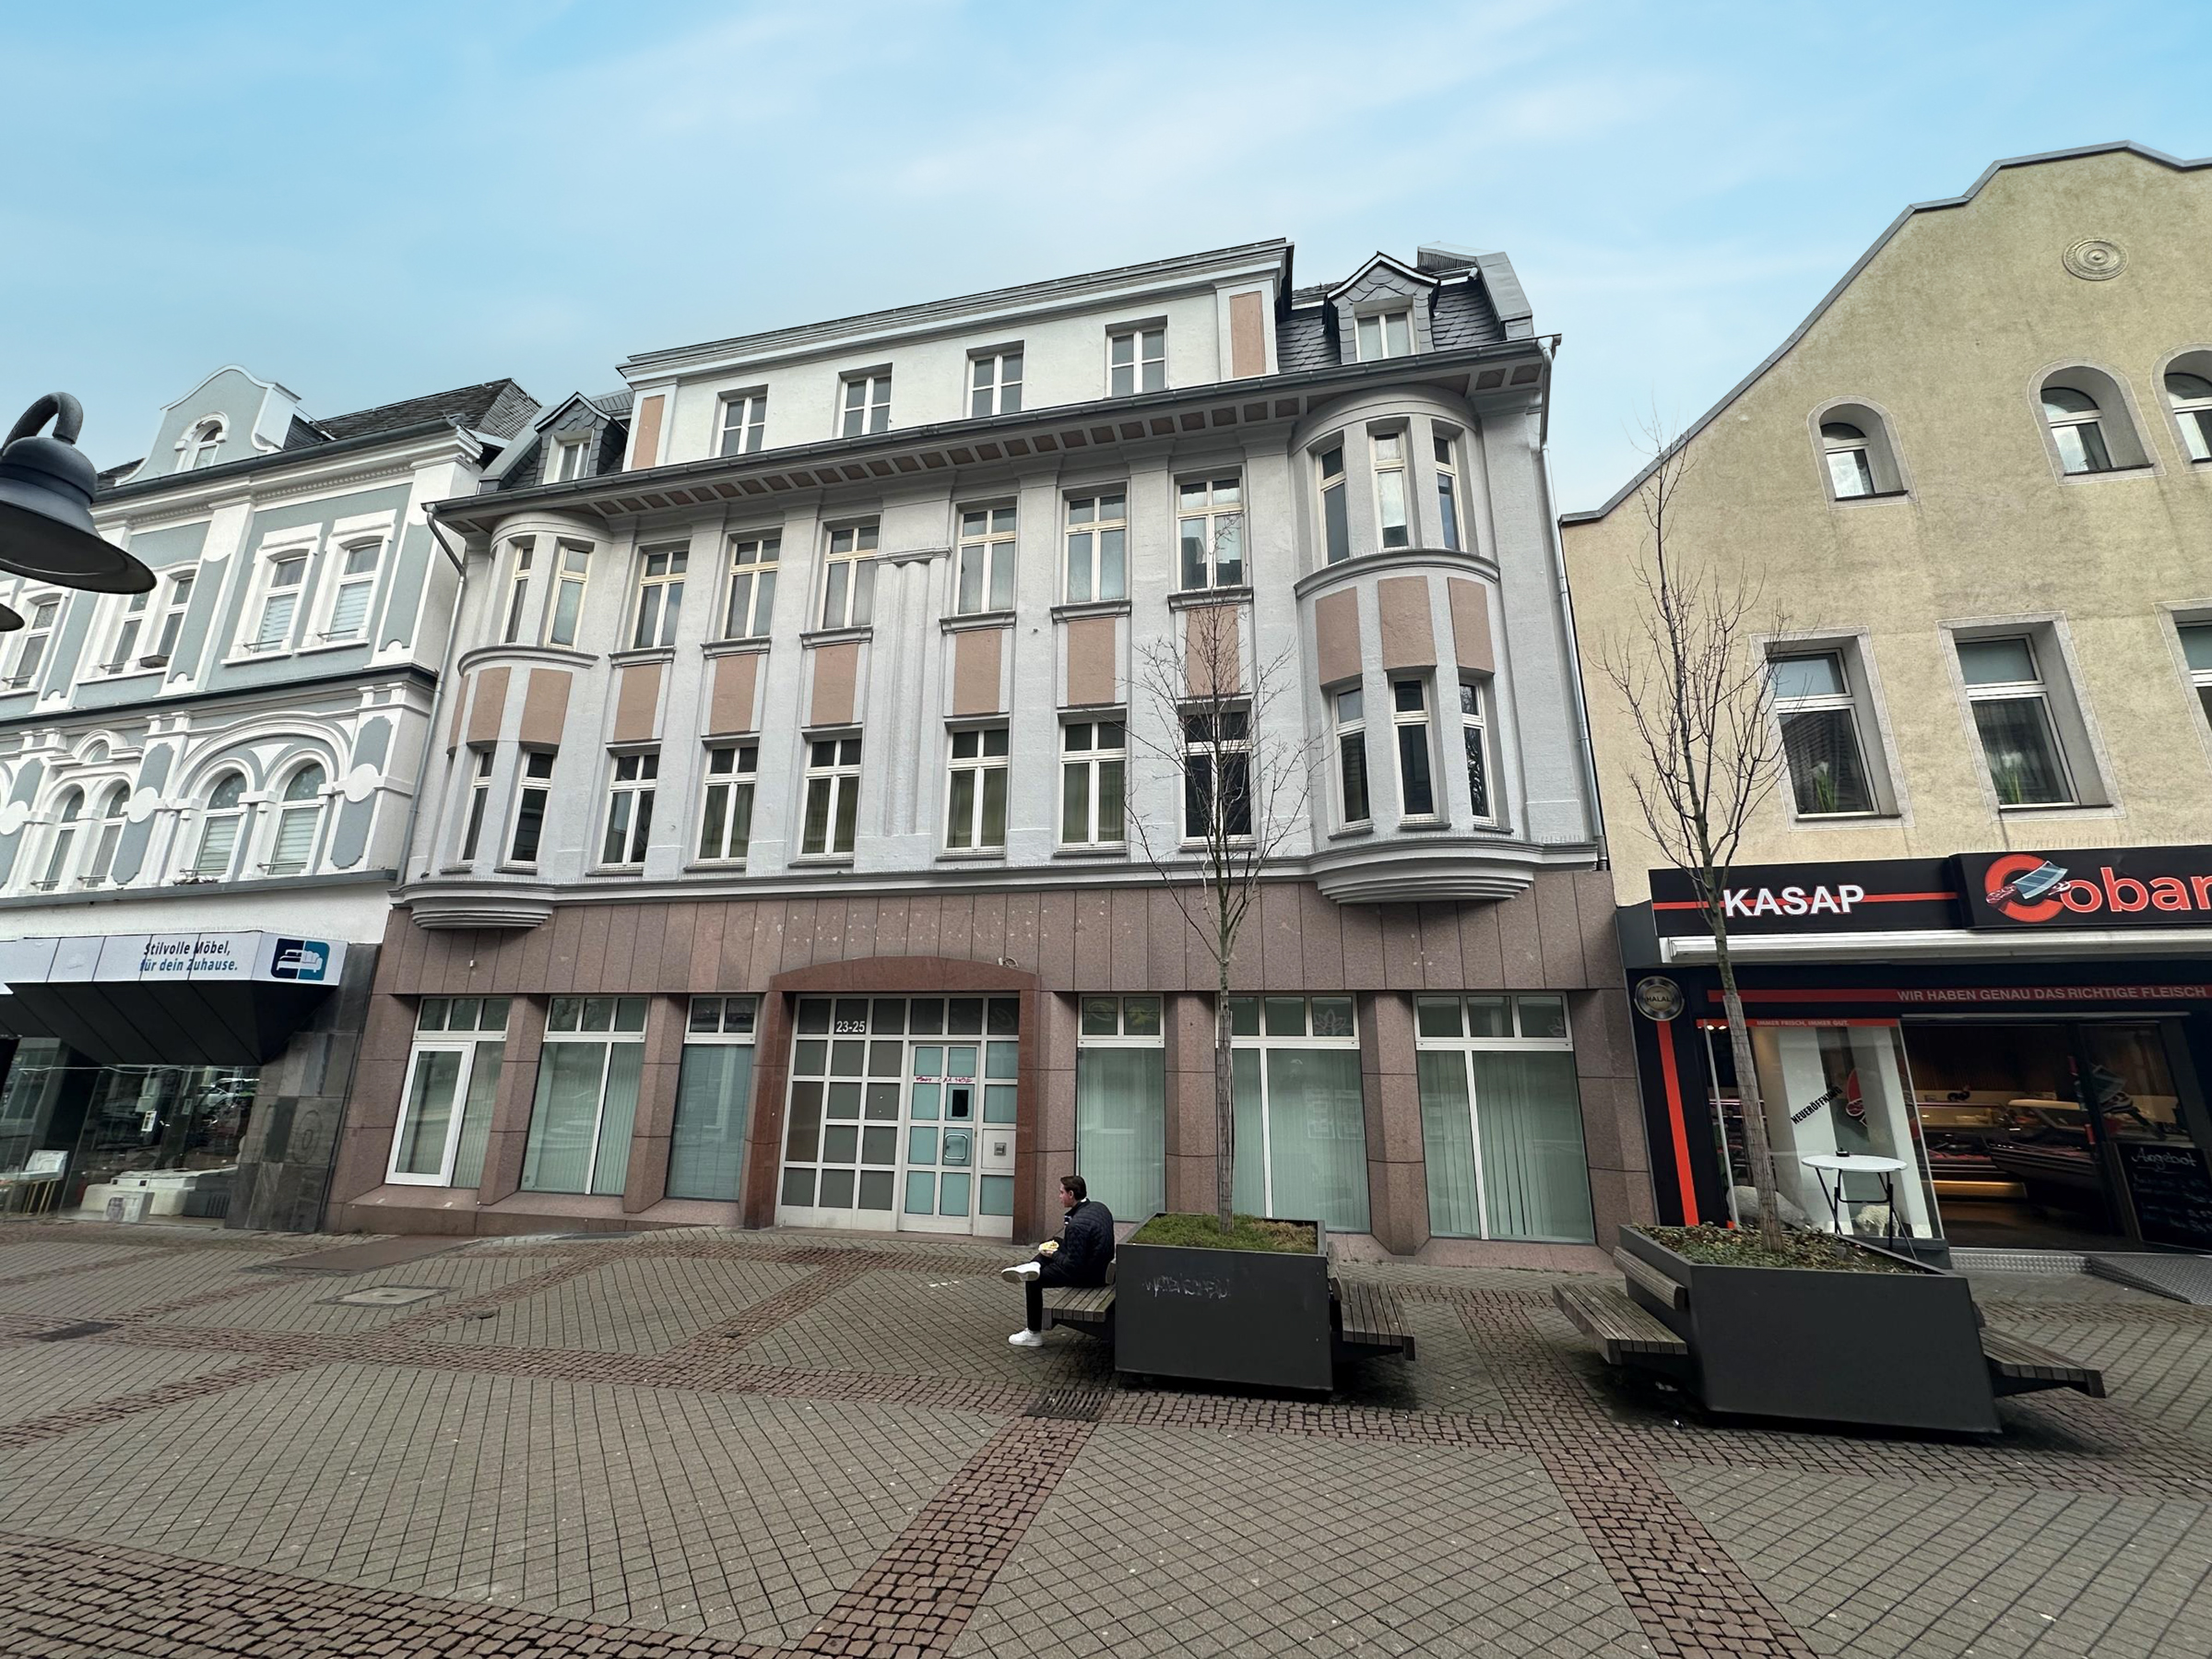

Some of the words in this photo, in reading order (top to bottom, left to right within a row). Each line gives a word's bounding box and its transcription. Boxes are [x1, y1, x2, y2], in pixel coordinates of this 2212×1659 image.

[1722, 884, 1864, 918] KASAP
[144, 942, 190, 955] Stilvolle
[193, 941, 231, 955] Möbel,
[139, 958, 157, 971] für
[160, 958, 183, 971] dein
[186, 958, 238, 971] Zuhause.
[1897, 989, 1924, 1001] WIR
[1927, 989, 1977, 1001] HABEN
[1980, 989, 2030, 1001] GENAU
[2034, 989, 2065, 999] DAS
[2067, 988, 2139, 999] RICHTIGE
[2142, 987, 2206, 998] FLEISCH
[835, 1020, 866, 1033] 23-25
[1791, 1085, 1843, 1125] NEUERÖFFNUNG
[2131, 1146, 2197, 1171] Angebot
